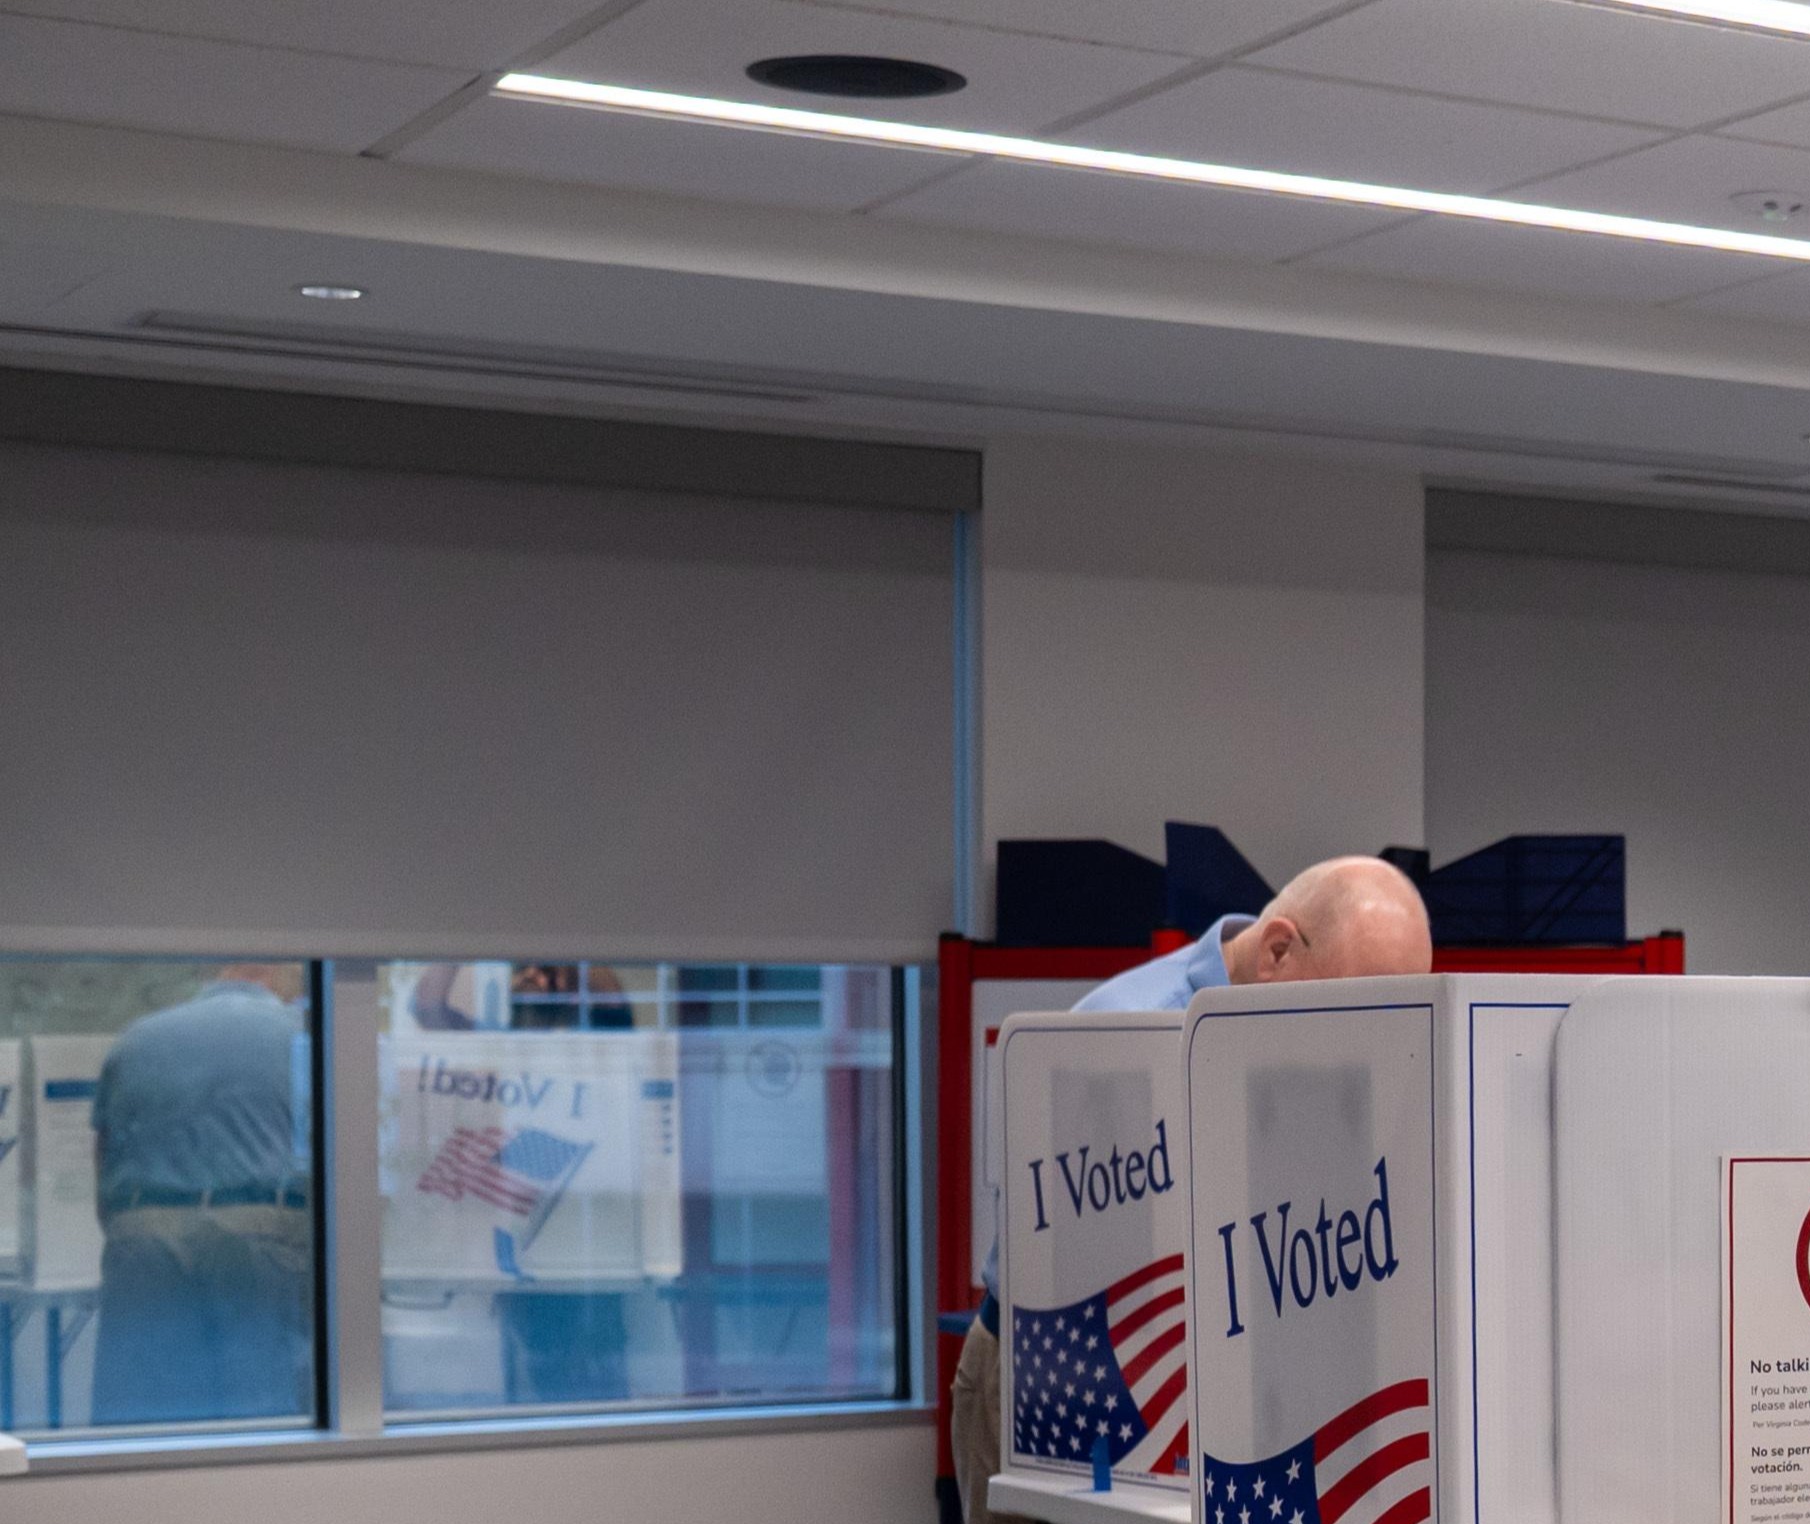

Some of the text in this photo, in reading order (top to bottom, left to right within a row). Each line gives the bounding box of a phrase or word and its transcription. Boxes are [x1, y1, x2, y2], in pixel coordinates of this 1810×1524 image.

[1029, 1120, 1174, 1231] I Voted
[1219, 1157, 1399, 1338] I Voted
[1751, 1360, 1771, 1374] No
[1751, 1386, 1758, 1396] If
[1761, 1387, 1780, 1397] you
[1783, 1383, 1807, 1394] have
[1751, 1399, 1785, 1413] please
[1751, 1447, 1767, 1457] No
[1771, 1447, 1784, 1457] se
[1751, 1461, 1803, 1474] votación.
[1751, 1485, 1759, 1493] Si
[1761, 1483, 1782, 1492] tiene
[1751, 1496, 1794, 1507] trabajador
